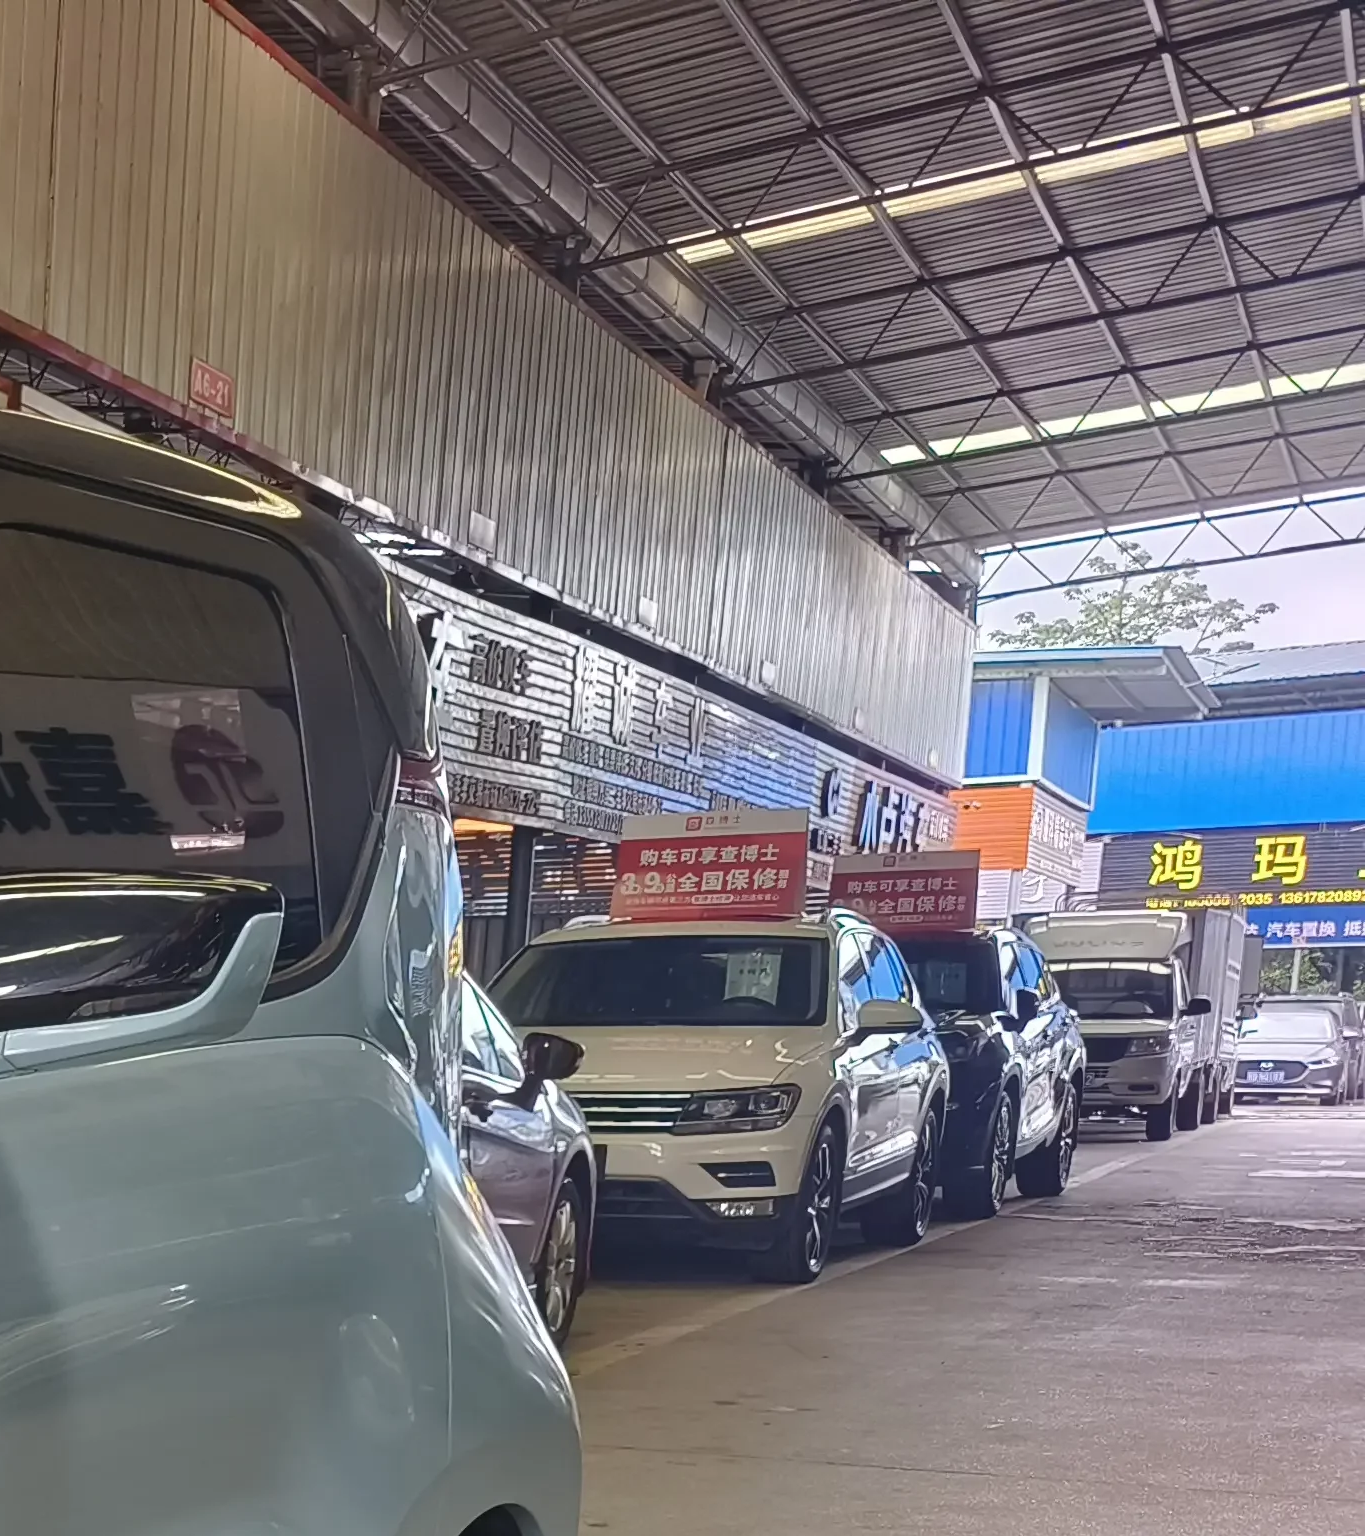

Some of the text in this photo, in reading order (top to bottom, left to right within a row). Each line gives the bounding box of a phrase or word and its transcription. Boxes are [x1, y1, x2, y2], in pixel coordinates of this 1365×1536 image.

[193, 367, 229, 408] A6-21
[639, 844, 780, 867] 购车可享查博士
[847, 877, 959, 894] 购车可享查博士
[1266, 919, 1337, 938] 汽车置换
